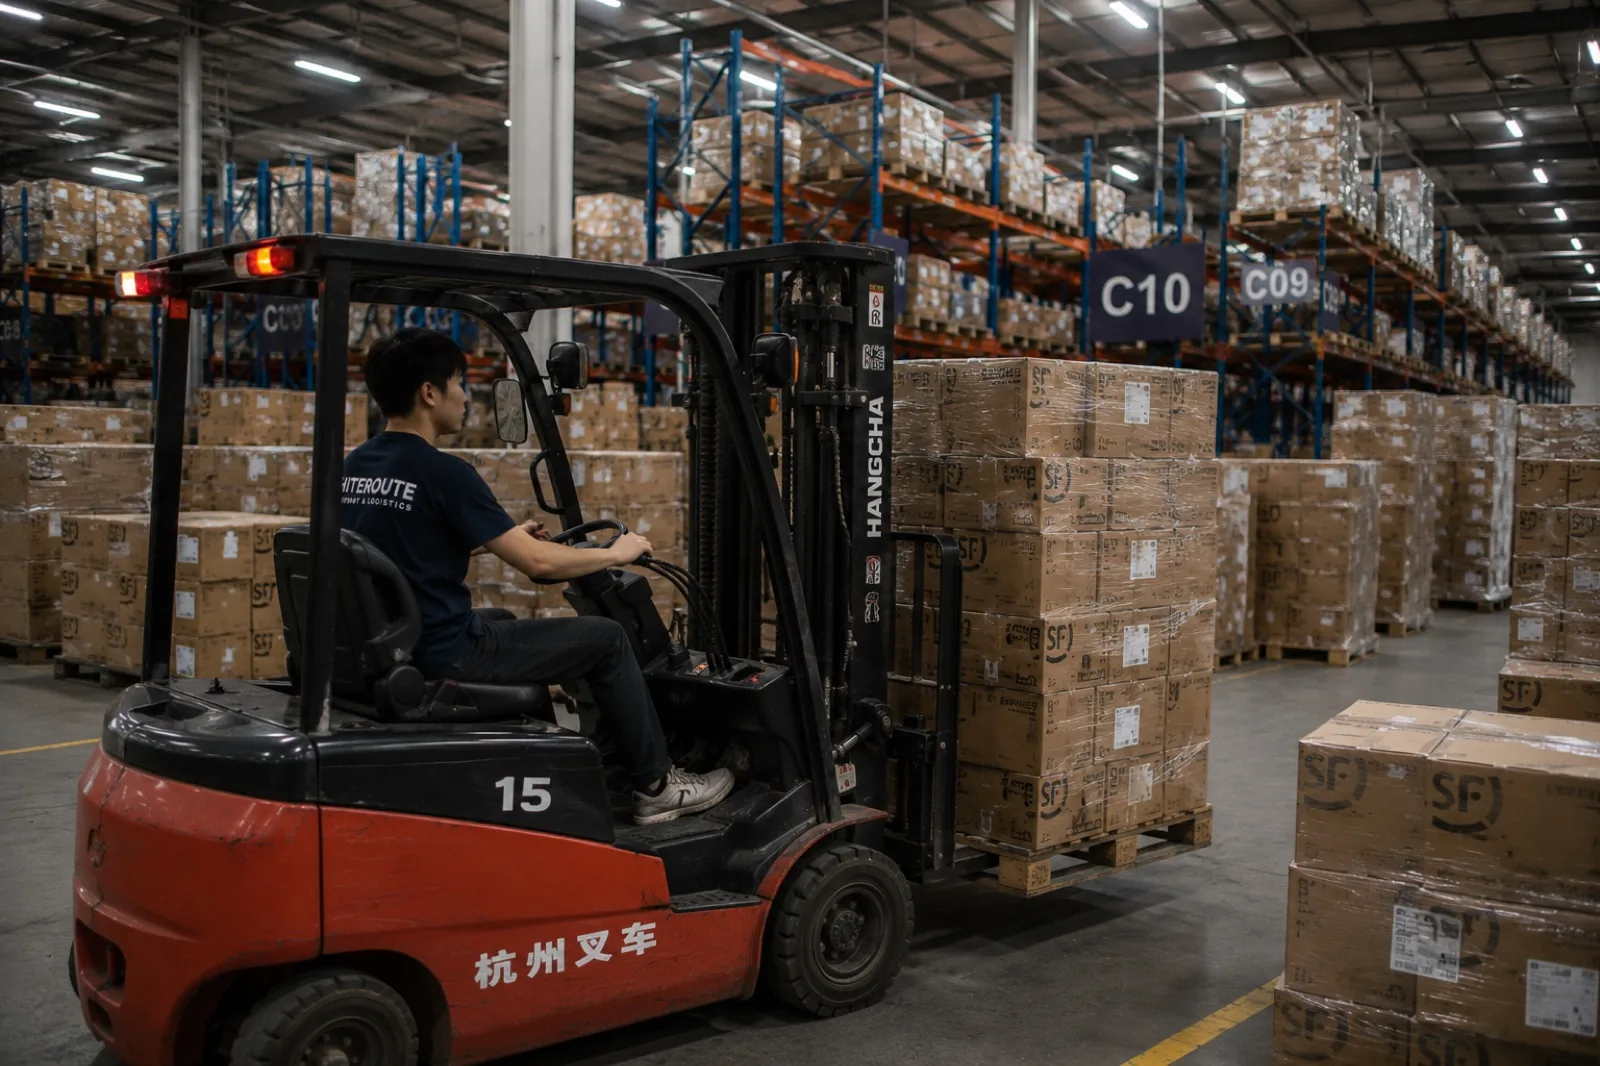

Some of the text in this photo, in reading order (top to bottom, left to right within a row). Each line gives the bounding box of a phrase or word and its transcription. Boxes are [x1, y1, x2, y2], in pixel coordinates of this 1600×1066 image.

[1101, 272, 1191, 316] C10
[1245, 268, 1308, 300] C09
[867, 396, 884, 538] HANGCHA
[368, 498, 412, 511] LOGISTICS
[494, 776, 552, 812] 15
[474, 921, 657, 990] 杭州叉车
